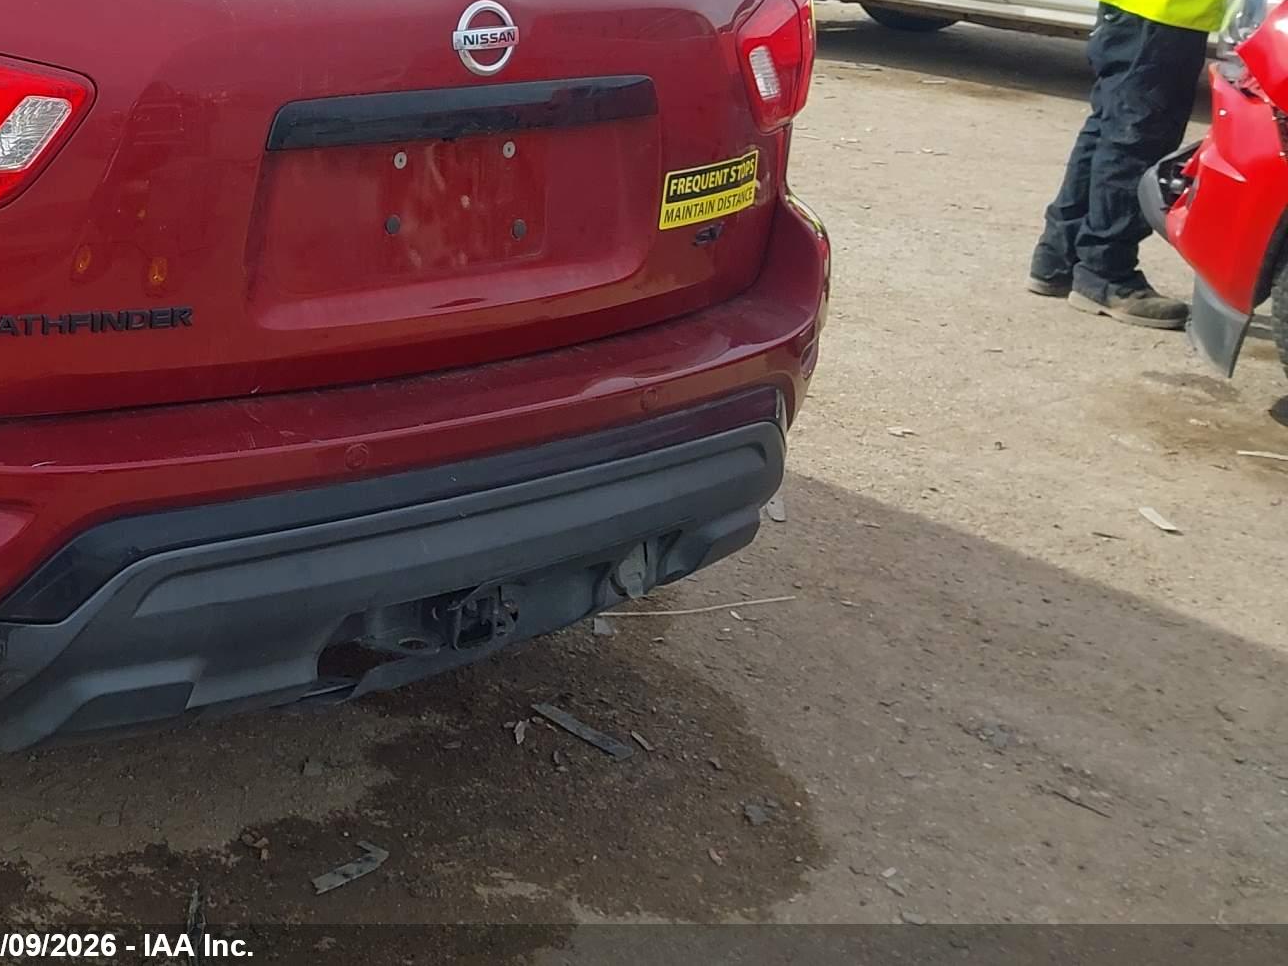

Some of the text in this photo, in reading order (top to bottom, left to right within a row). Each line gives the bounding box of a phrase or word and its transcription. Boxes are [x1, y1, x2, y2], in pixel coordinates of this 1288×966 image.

[463, 30, 515, 46] NISSAN
[669, 158, 755, 197] FREQUENT STOPS
[663, 186, 753, 224] MAINTAIN DISTANCE
